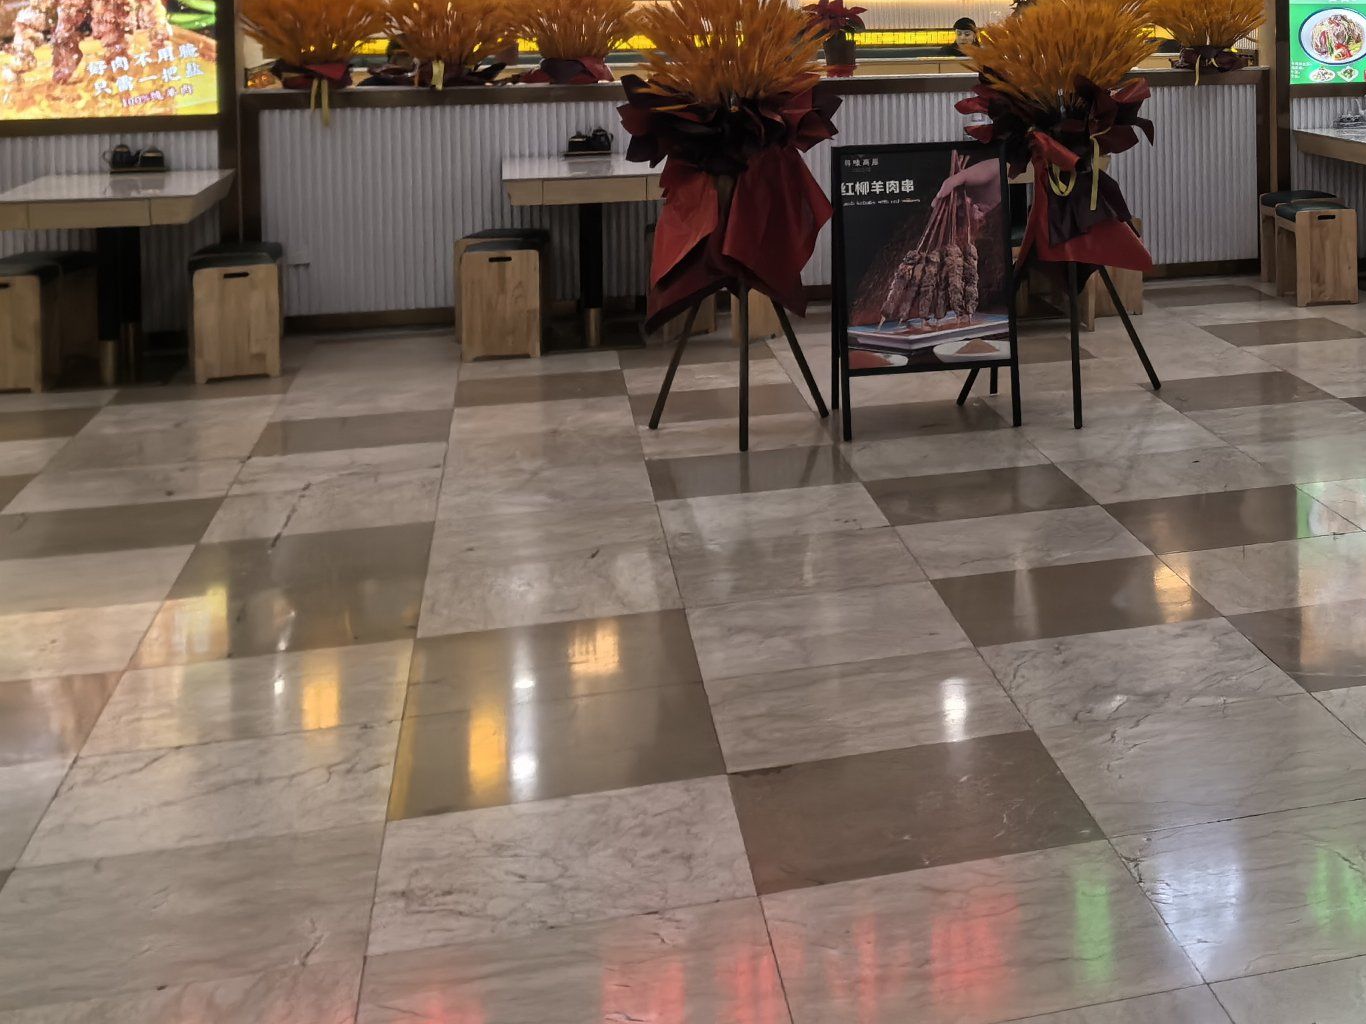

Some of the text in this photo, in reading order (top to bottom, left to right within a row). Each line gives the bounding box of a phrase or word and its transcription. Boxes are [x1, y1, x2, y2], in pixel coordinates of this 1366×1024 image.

[840, 178, 915, 196] 红柳羊肉串
